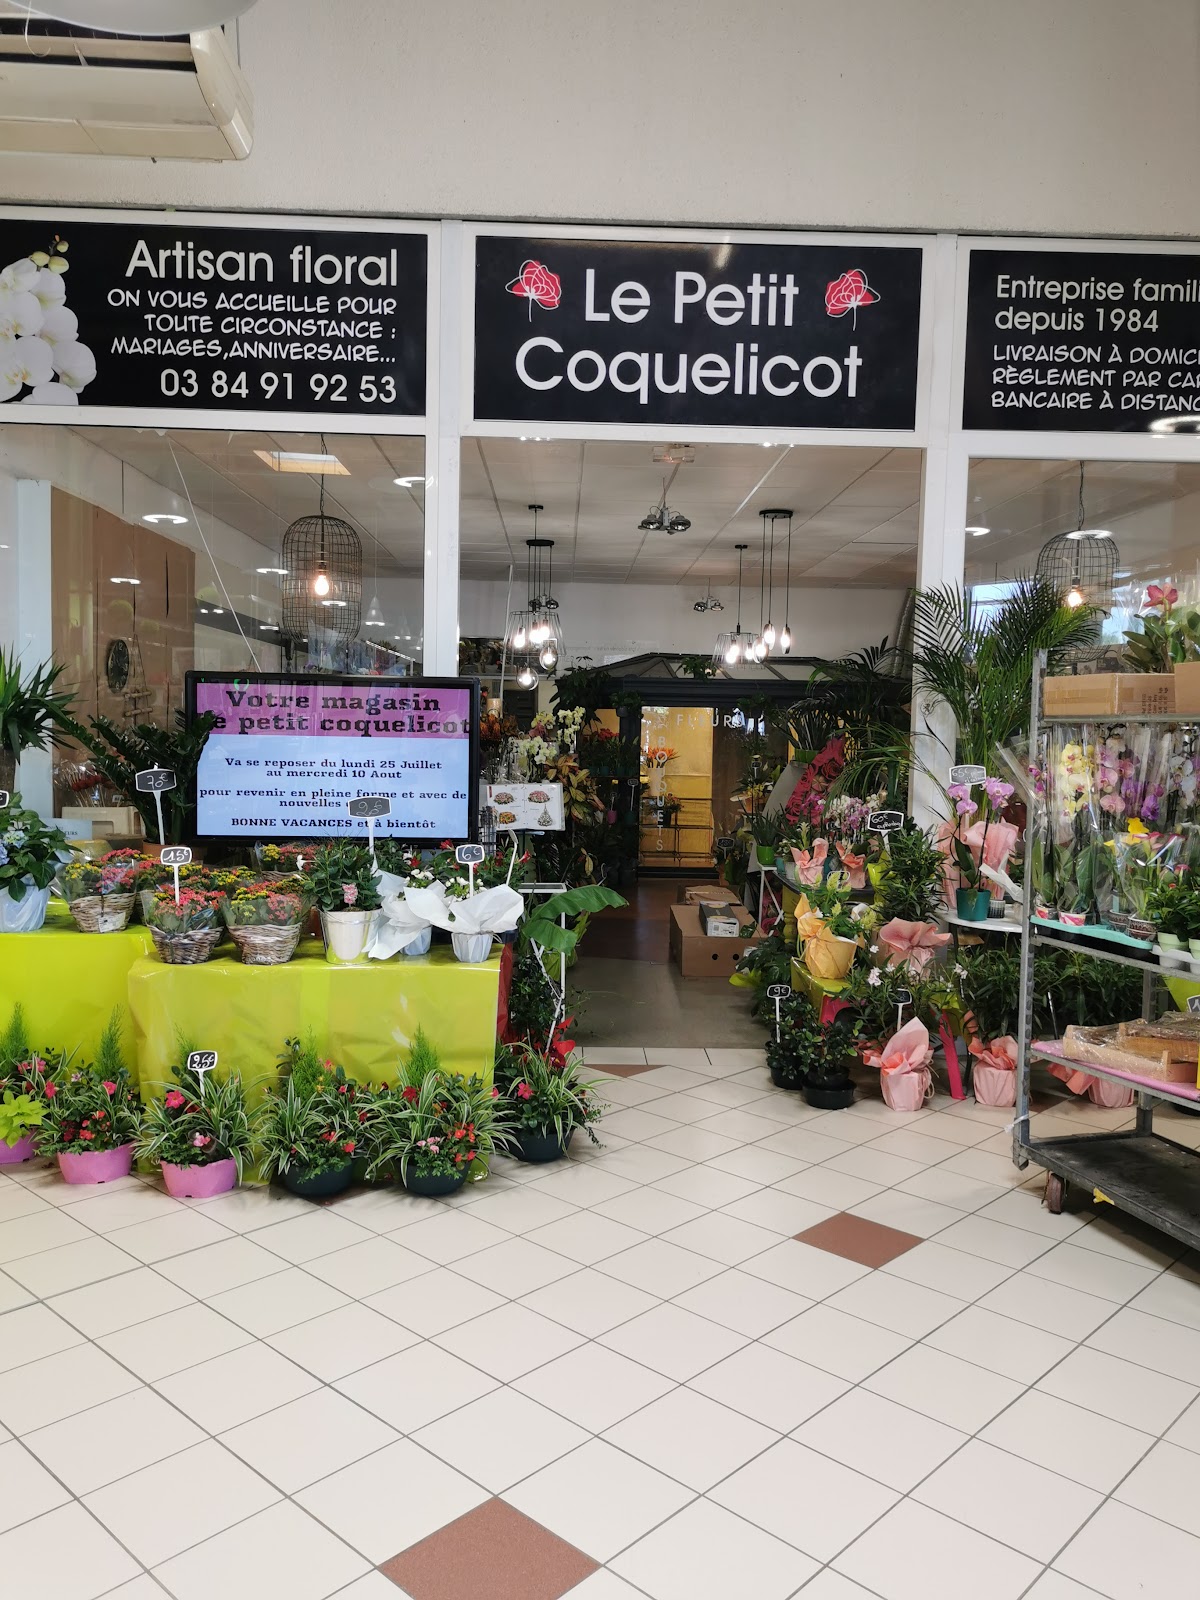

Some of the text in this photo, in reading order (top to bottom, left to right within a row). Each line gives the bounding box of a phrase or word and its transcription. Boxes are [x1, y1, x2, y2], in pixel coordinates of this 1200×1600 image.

[126, 240, 397, 287] Artisan floral
[107, 288, 397, 316] ON VOUS ACCUEILLE POUR
[585, 268, 800, 327] Le Petit
[996, 274, 1125, 305] Entreprise
[143, 313, 214, 334] TOUTE
[220, 316, 383, 339] CIRCONSTANCE
[994, 305, 1159, 335] depuis 1984
[993, 344, 1102, 364] LIVRAISON
[1107, 343, 1123, 364] À
[515, 336, 863, 405] Coquelicot
[992, 364, 1200, 389] RÈGLEMENT PAR CA
[160, 368, 397, 404] 03 84 91 92 53
[991, 390, 1093, 410] BANCAIRE
[1098, 389, 1114, 410] À
[226, 691, 441, 715] Votre magasin
[238, 712, 310, 735] petit
[320, 715, 470, 737] coquelicot
[224, 757, 242, 766] Va
[264, 760, 316, 770] reposer
[321, 758, 337, 768] du
[341, 758, 375, 769] lundi
[379, 760, 396, 769] 25
[401, 759, 442, 769] Juillet
[287, 768, 348, 778] mercredi
[352, 769, 366, 778] 10
[370, 769, 402, 778] Aout
[199, 788, 466, 800] pour revenir en pleine forme et avec de
[279, 798, 341, 808] nouvelles
[231, 818, 436, 829] BONNE VACANCES et à bientôt
